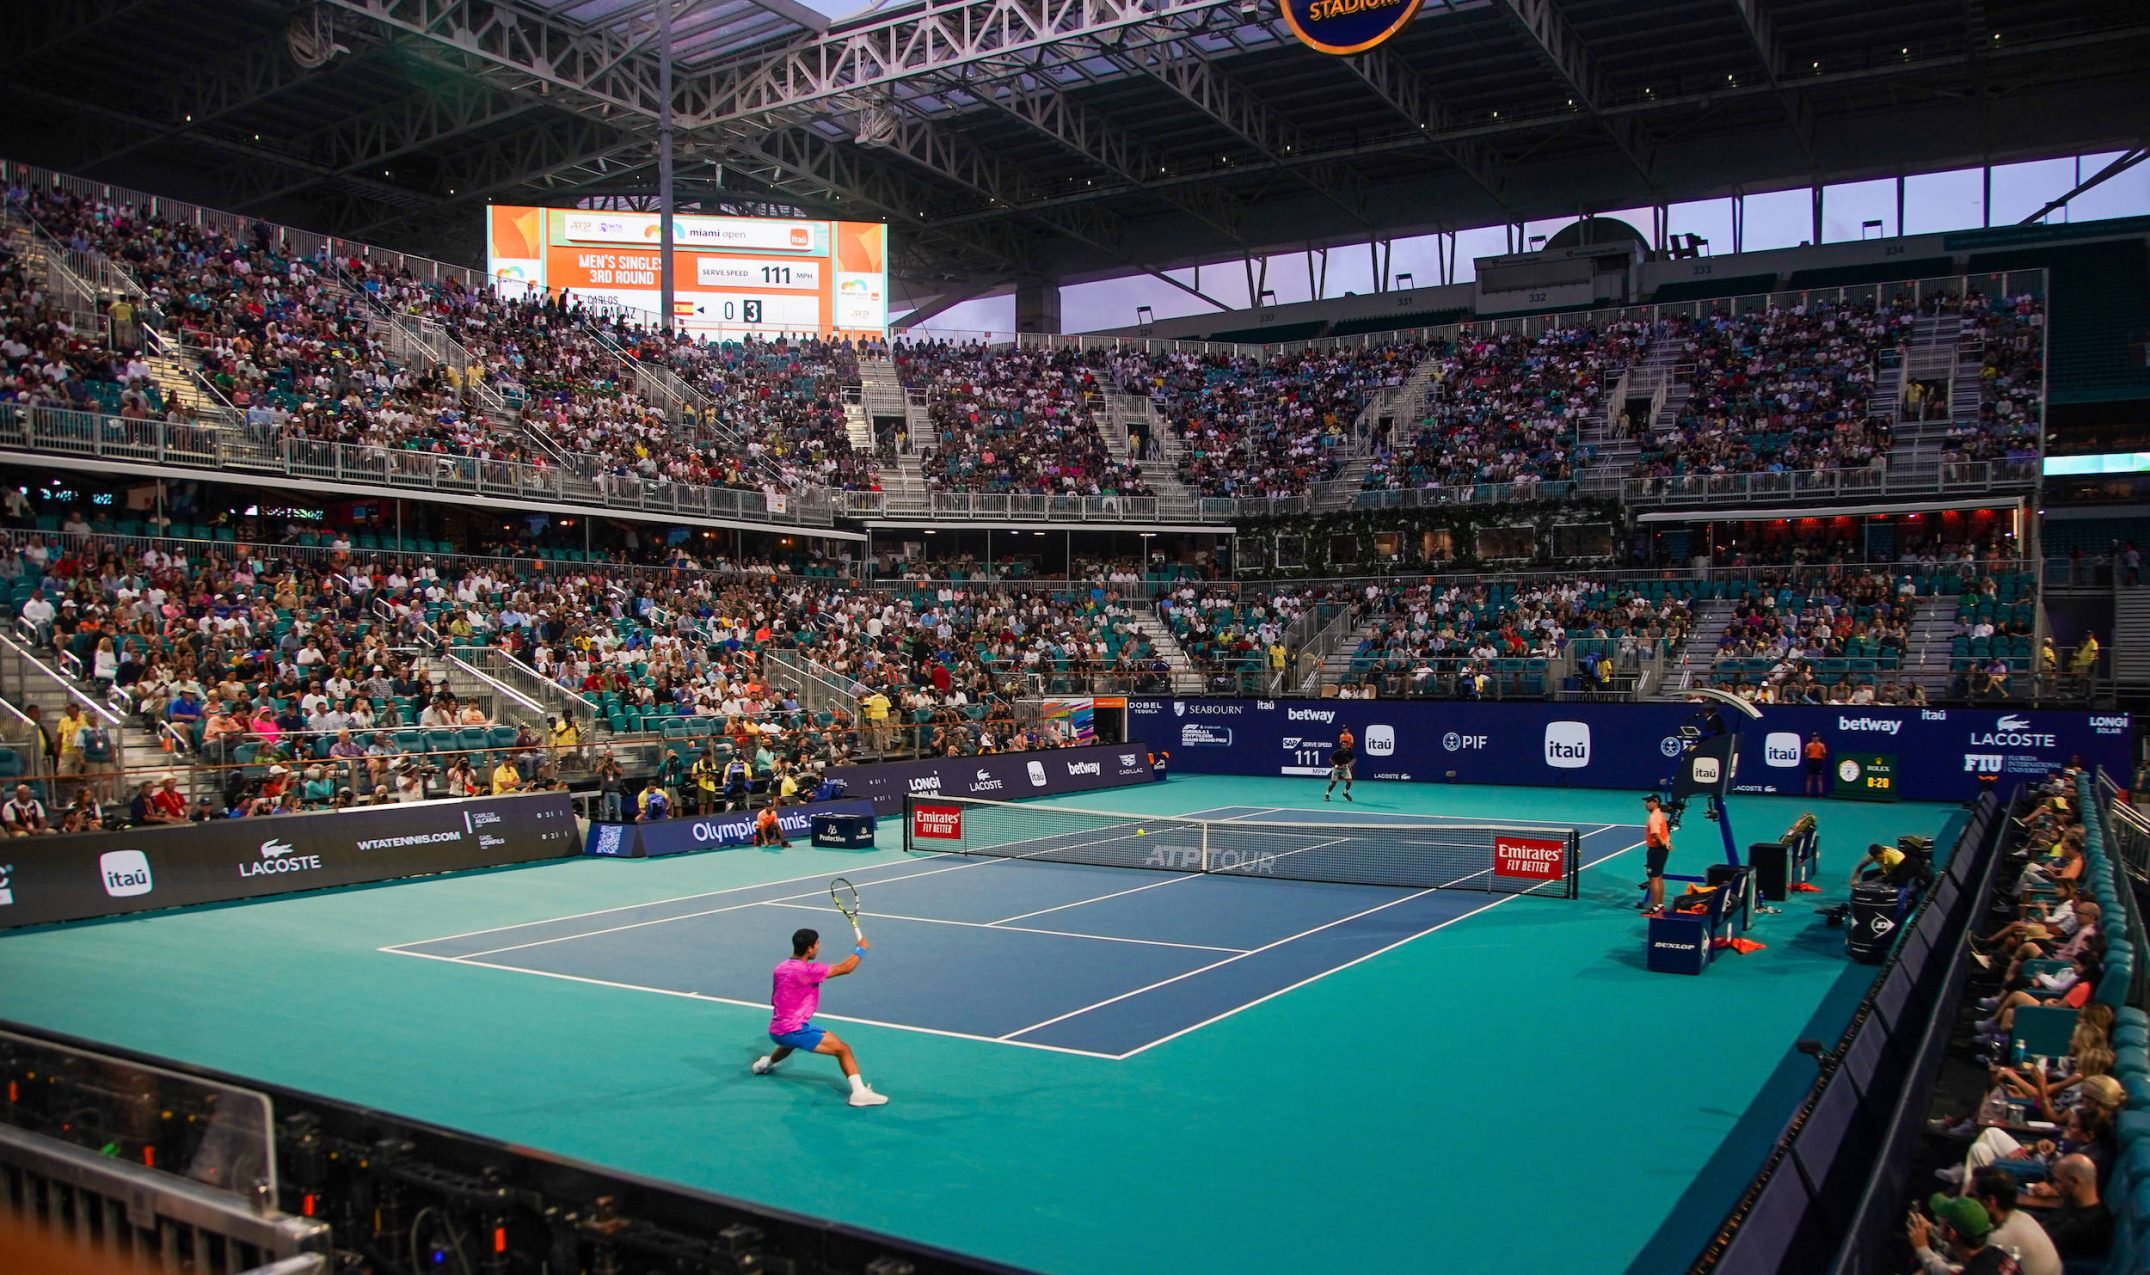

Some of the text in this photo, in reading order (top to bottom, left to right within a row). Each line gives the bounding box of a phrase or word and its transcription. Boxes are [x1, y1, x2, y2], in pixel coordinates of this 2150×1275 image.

[689, 228, 746, 240] miami open
[579, 254, 616, 269] MEN'S
[589, 269, 655, 285] 3RD ROUND
[702, 266, 813, 284] SERVE SPEED 111 MPH
[587, 295, 619, 305] CARLOS
[724, 301, 759, 322] 0 3
[1189, 705, 1243, 715] SEABOURN
[1288, 708, 1336, 724] betway
[1838, 716, 1903, 735] betway
[1283, 738, 1298, 747] SAP
[1368, 738, 1392, 750] itaú
[1462, 735, 1488, 750] PIF
[1970, 733, 2056, 747] LACOSTE
[1548, 741, 1586, 759] itaú
[1768, 747, 1797, 760] itaú
[1294, 750, 1320, 766] 111
[1964, 753, 2003, 773] FIU
[2007, 761, 2063, 769] INTERNATIONAL
[1067, 761, 1100, 776] betway
[1119, 767, 1144, 776] CADILLAC
[1695, 768, 1717, 778] itaú
[969, 780, 1004, 792] LACOSTE
[916, 811, 959, 824] Emirates
[923, 823, 953, 834] FLY BETTER
[357, 831, 461, 851] WTATENNIS.COM
[819, 833, 846, 843] Protective
[1145, 844, 1277, 875] ATP TOUR
[1498, 843, 1560, 862] Emirates
[239, 855, 323, 878] LACOSTE
[1507, 859, 1550, 873] FLY BETTER
[107, 869, 148, 889] itaú
[1654, 942, 1696, 950] DUNLOP
